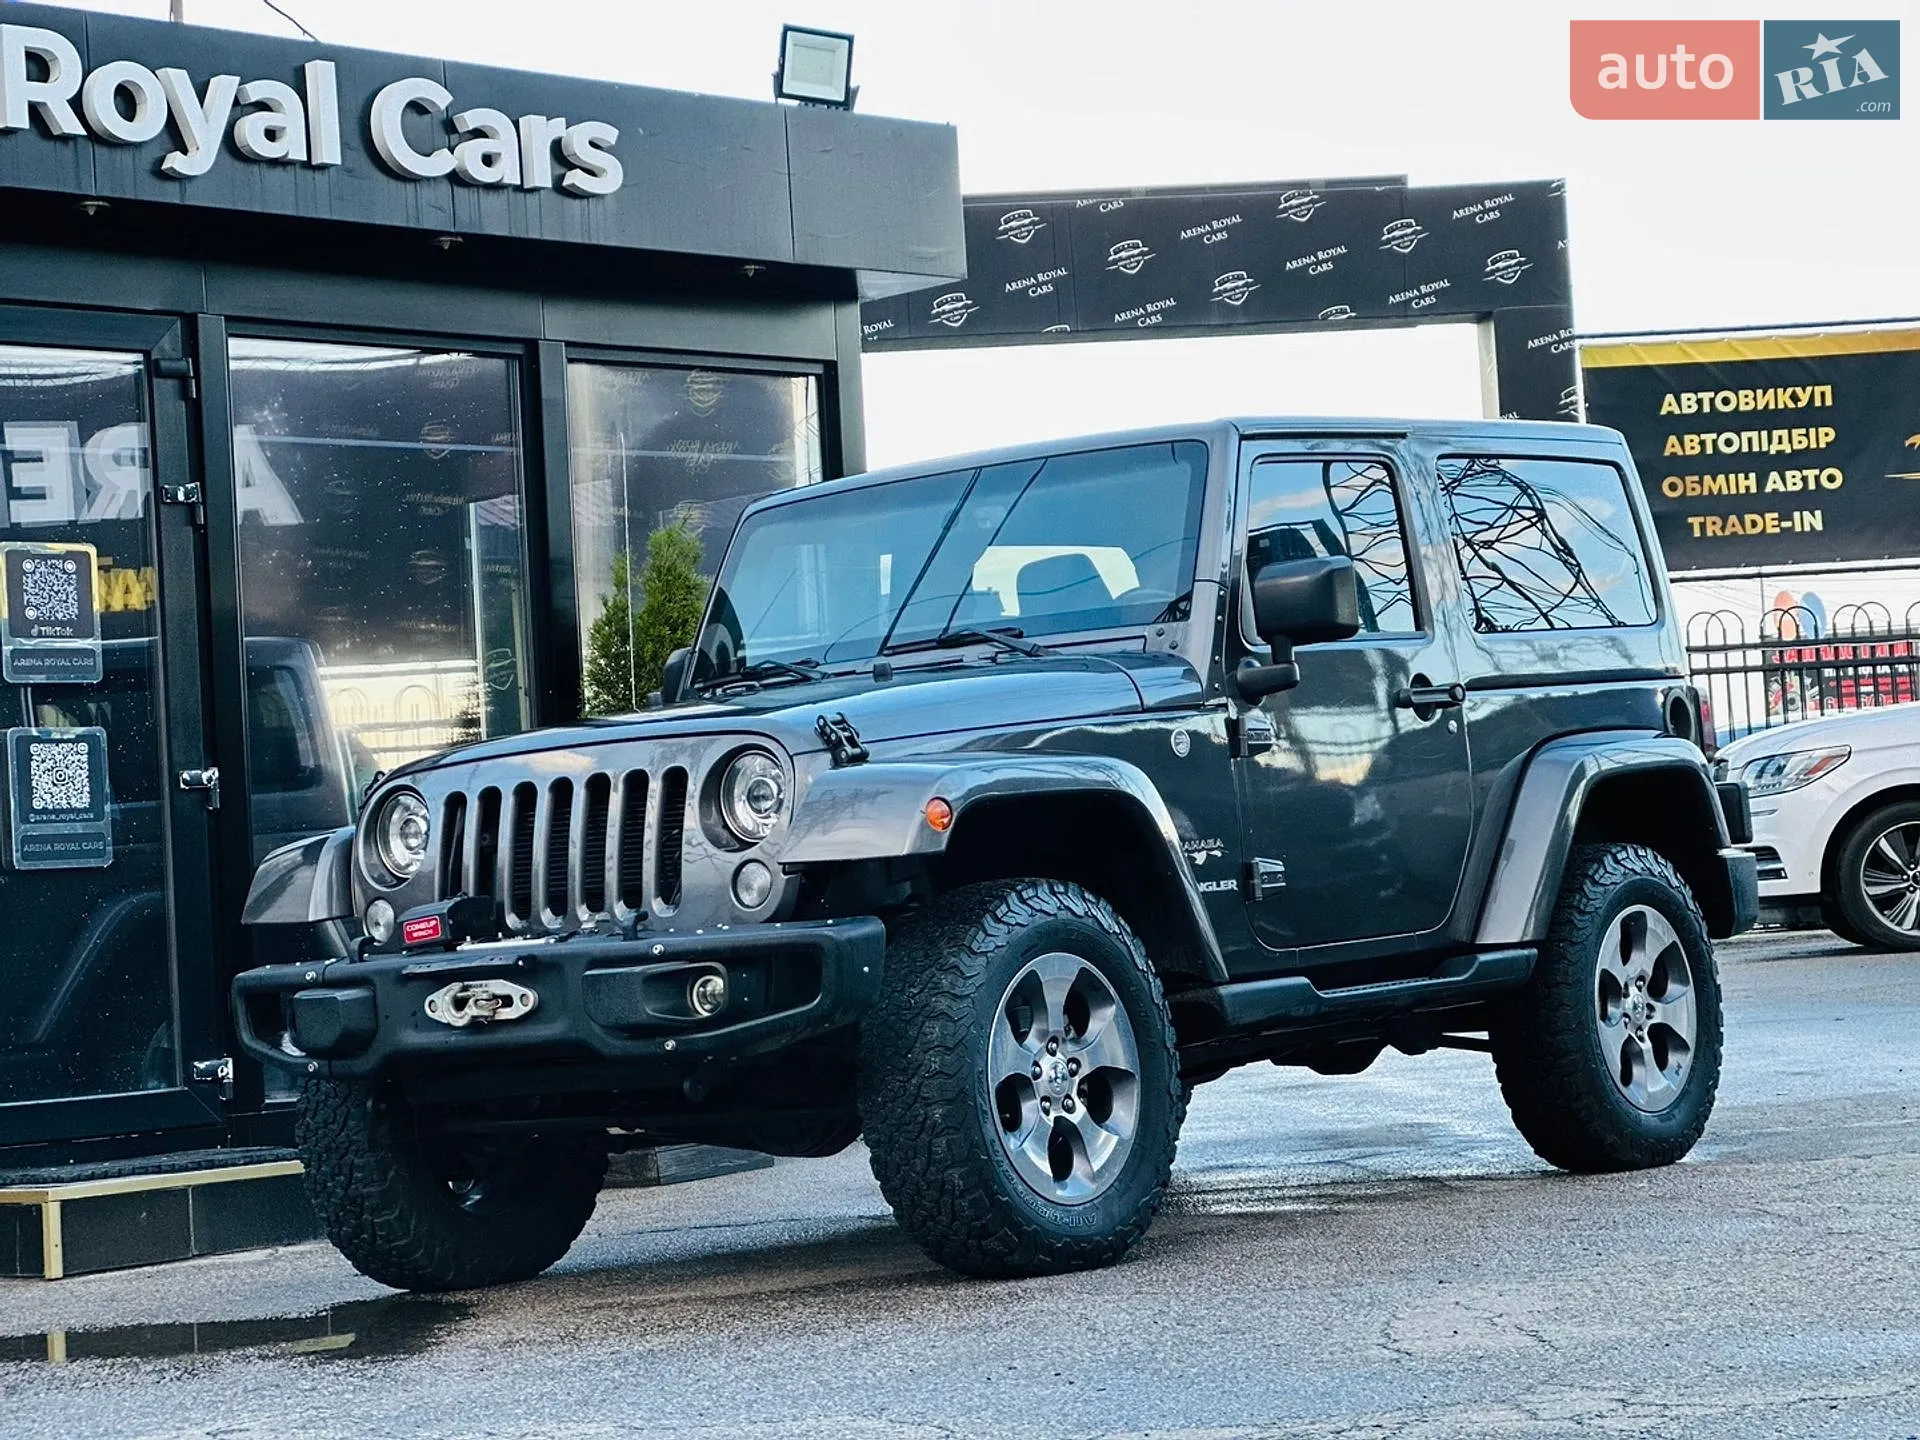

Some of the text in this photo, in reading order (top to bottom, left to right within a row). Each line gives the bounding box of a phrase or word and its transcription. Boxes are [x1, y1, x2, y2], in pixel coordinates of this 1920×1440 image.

[0, 24, 623, 195] Royal Cars
[1660, 385, 1833, 415] АВТОВИКУП
[1663, 427, 1836, 456] АВТОПІДБІР
[1661, 467, 1843, 498] ОБМІН АВТО
[1687, 510, 1824, 538] TRADE-IN
[40, 626, 74, 636] TikTok
